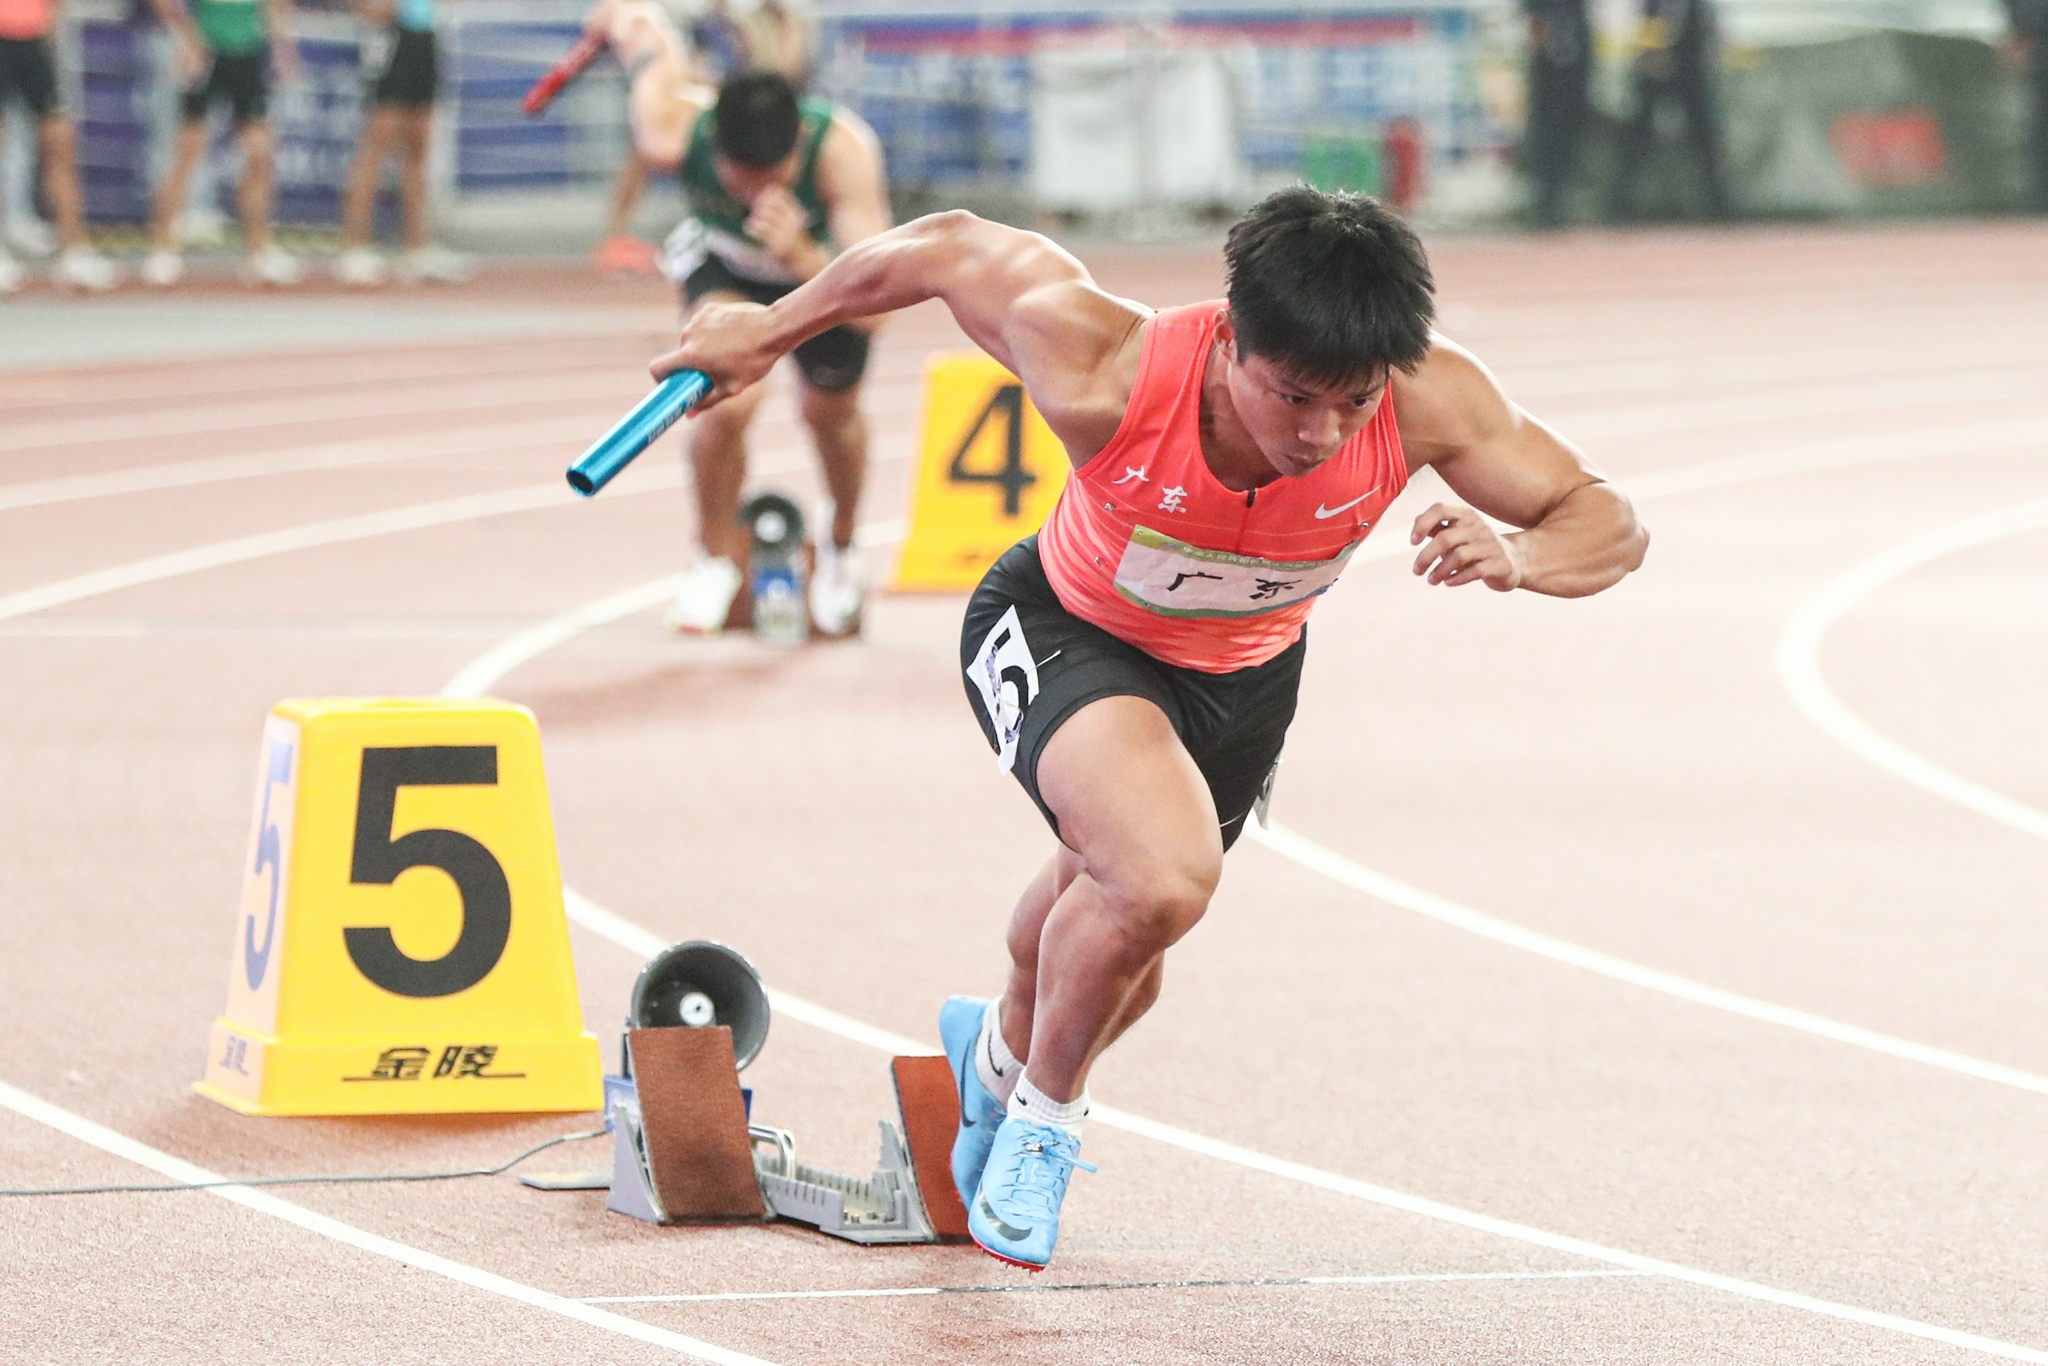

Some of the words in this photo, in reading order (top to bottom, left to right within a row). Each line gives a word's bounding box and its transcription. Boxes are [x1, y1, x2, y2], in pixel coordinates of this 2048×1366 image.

[949, 384, 1037, 516] 4
[245, 739, 294, 992] 5
[342, 745, 512, 999] 5
[370, 1045, 499, 1080] 金陵
